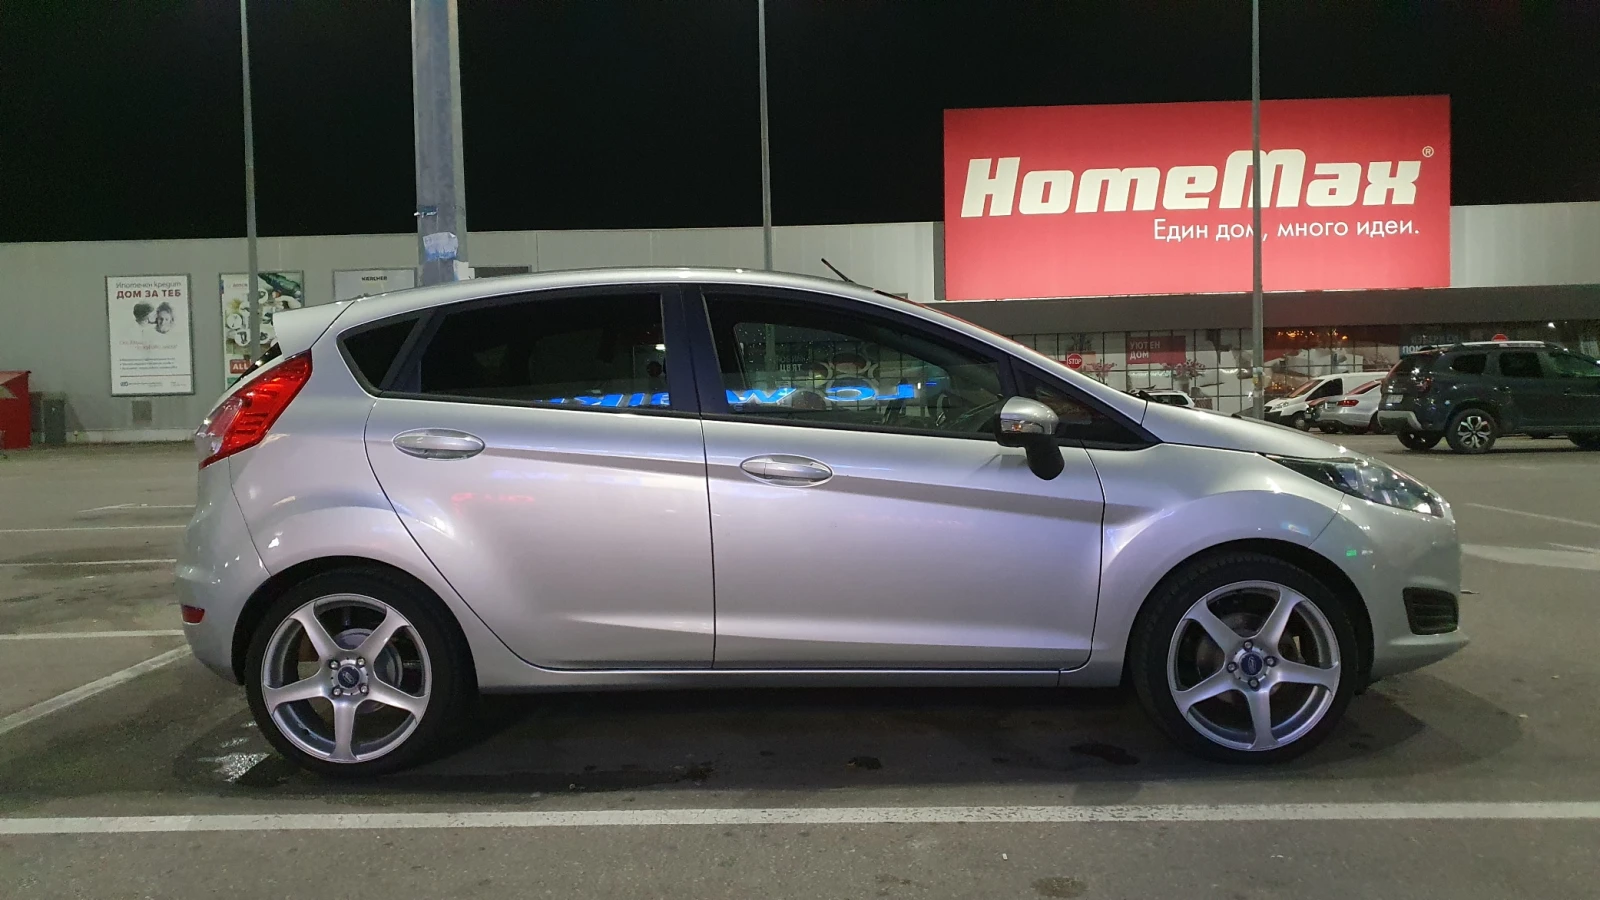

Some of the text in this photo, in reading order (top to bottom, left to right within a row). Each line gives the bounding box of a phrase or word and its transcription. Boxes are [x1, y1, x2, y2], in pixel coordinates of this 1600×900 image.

[961, 148, 1422, 218] HomeMax
[1153, 218, 1208, 242] Един
[1277, 221, 1349, 238] много
[1356, 219, 1420, 238] идеи.
[153, 280, 182, 290] кредит
[116, 289, 182, 300] ДОМ ЗА ТЕБ
[1129, 341, 1161, 350] УЮТЕН
[1129, 351, 1149, 360] ДОМ
[779, 363, 802, 373] ЦВЯТ
